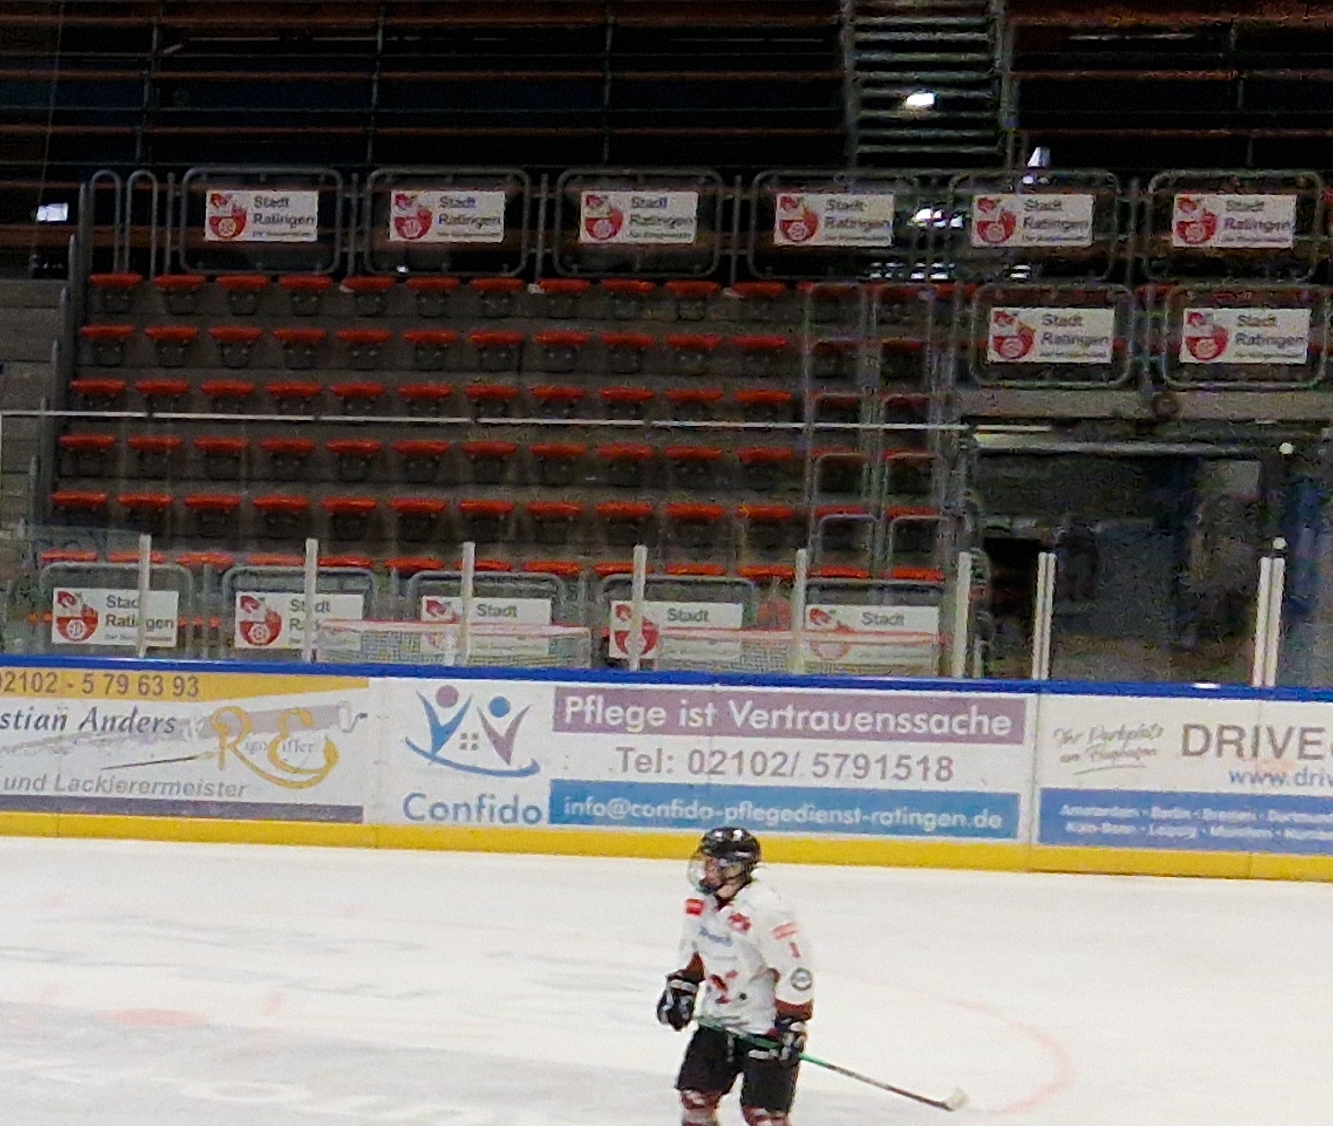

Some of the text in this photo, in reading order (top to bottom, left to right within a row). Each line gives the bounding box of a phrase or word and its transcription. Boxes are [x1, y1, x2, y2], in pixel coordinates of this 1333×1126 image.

[254, 213, 315, 227] Ratingen
[106, 594, 140, 609] Stad
[290, 599, 331, 612] Stdt
[477, 604, 518, 617] Stadt
[666, 607, 710, 620] Stadt
[105, 613, 174, 630] Ratigen
[861, 611, 905, 625] Stadt
[81, 672, 94, 694] 5
[103, 673, 130, 695] 79
[137, 674, 165, 696] 63
[172, 674, 200, 697] 93
[78, 706, 176, 735] Anders
[564, 694, 1014, 736] Pflege ist Vertrauenssache
[1182, 724, 1333, 760] DRIVE
[615, 747, 954, 783] Tel: 02102/ 5791518
[4, 770, 48, 792] und
[53, 772, 248, 798] Lackierermeister
[402, 792, 543, 824] Confido
[563, 797, 1003, 831] info@confido-pflegedienst-ratingen.de
